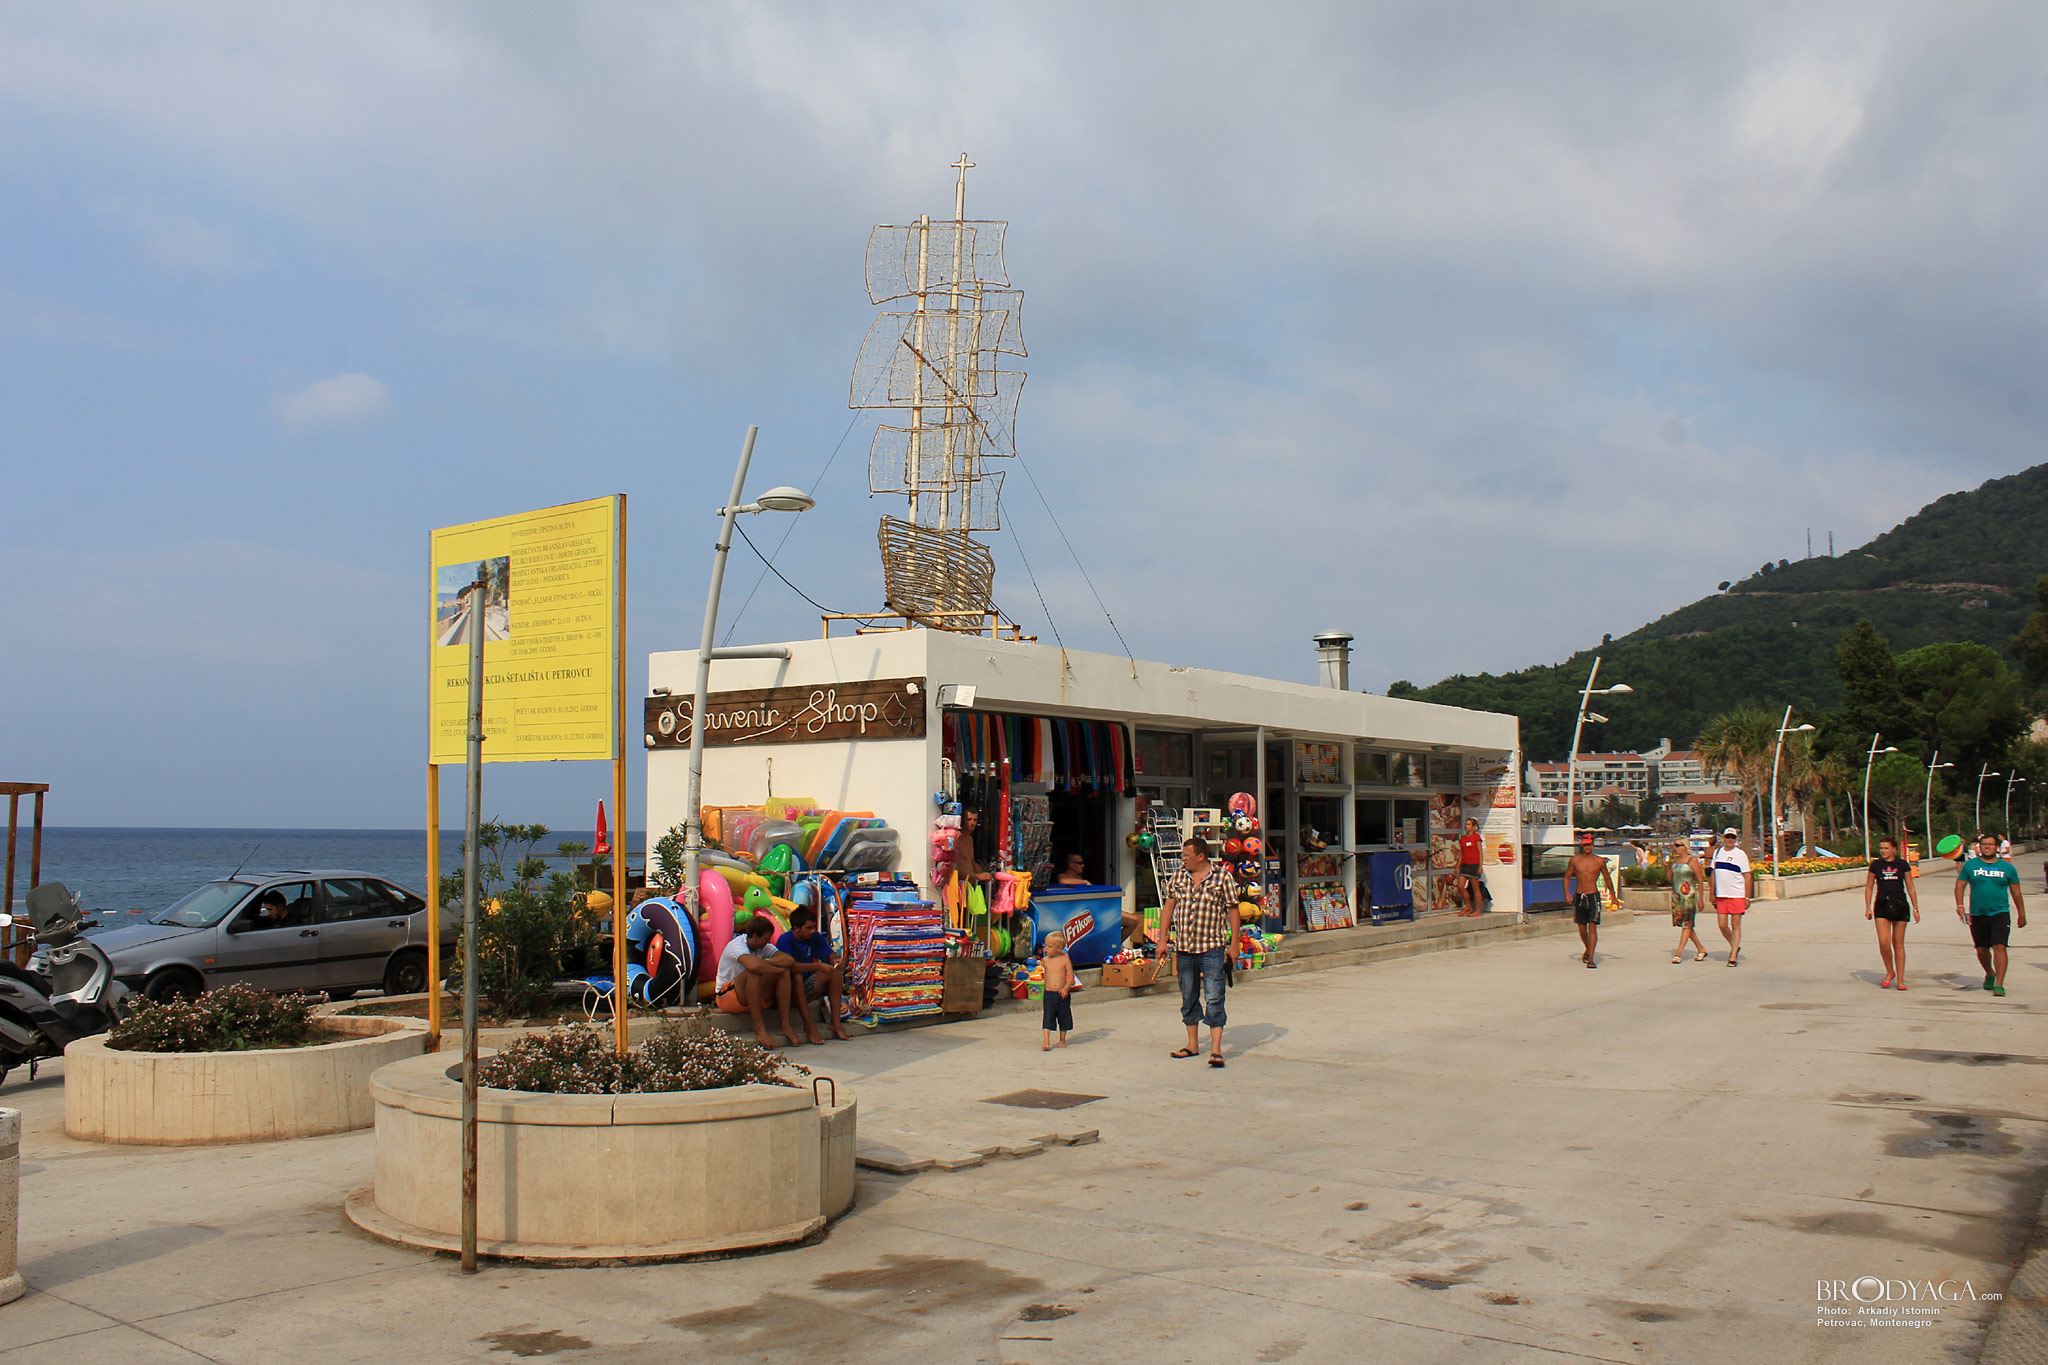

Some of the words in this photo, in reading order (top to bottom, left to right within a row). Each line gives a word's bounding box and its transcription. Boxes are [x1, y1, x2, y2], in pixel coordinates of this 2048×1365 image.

[446, 674, 506, 688] REKONKCIJA
[506, 670, 544, 683] ŠETALIŠTA
[546, 670, 550, 680] U
[552, 668, 592, 680] PETROVCU
[806, 689, 877, 734] Shop
[1066, 914, 1093, 942] Frikom
